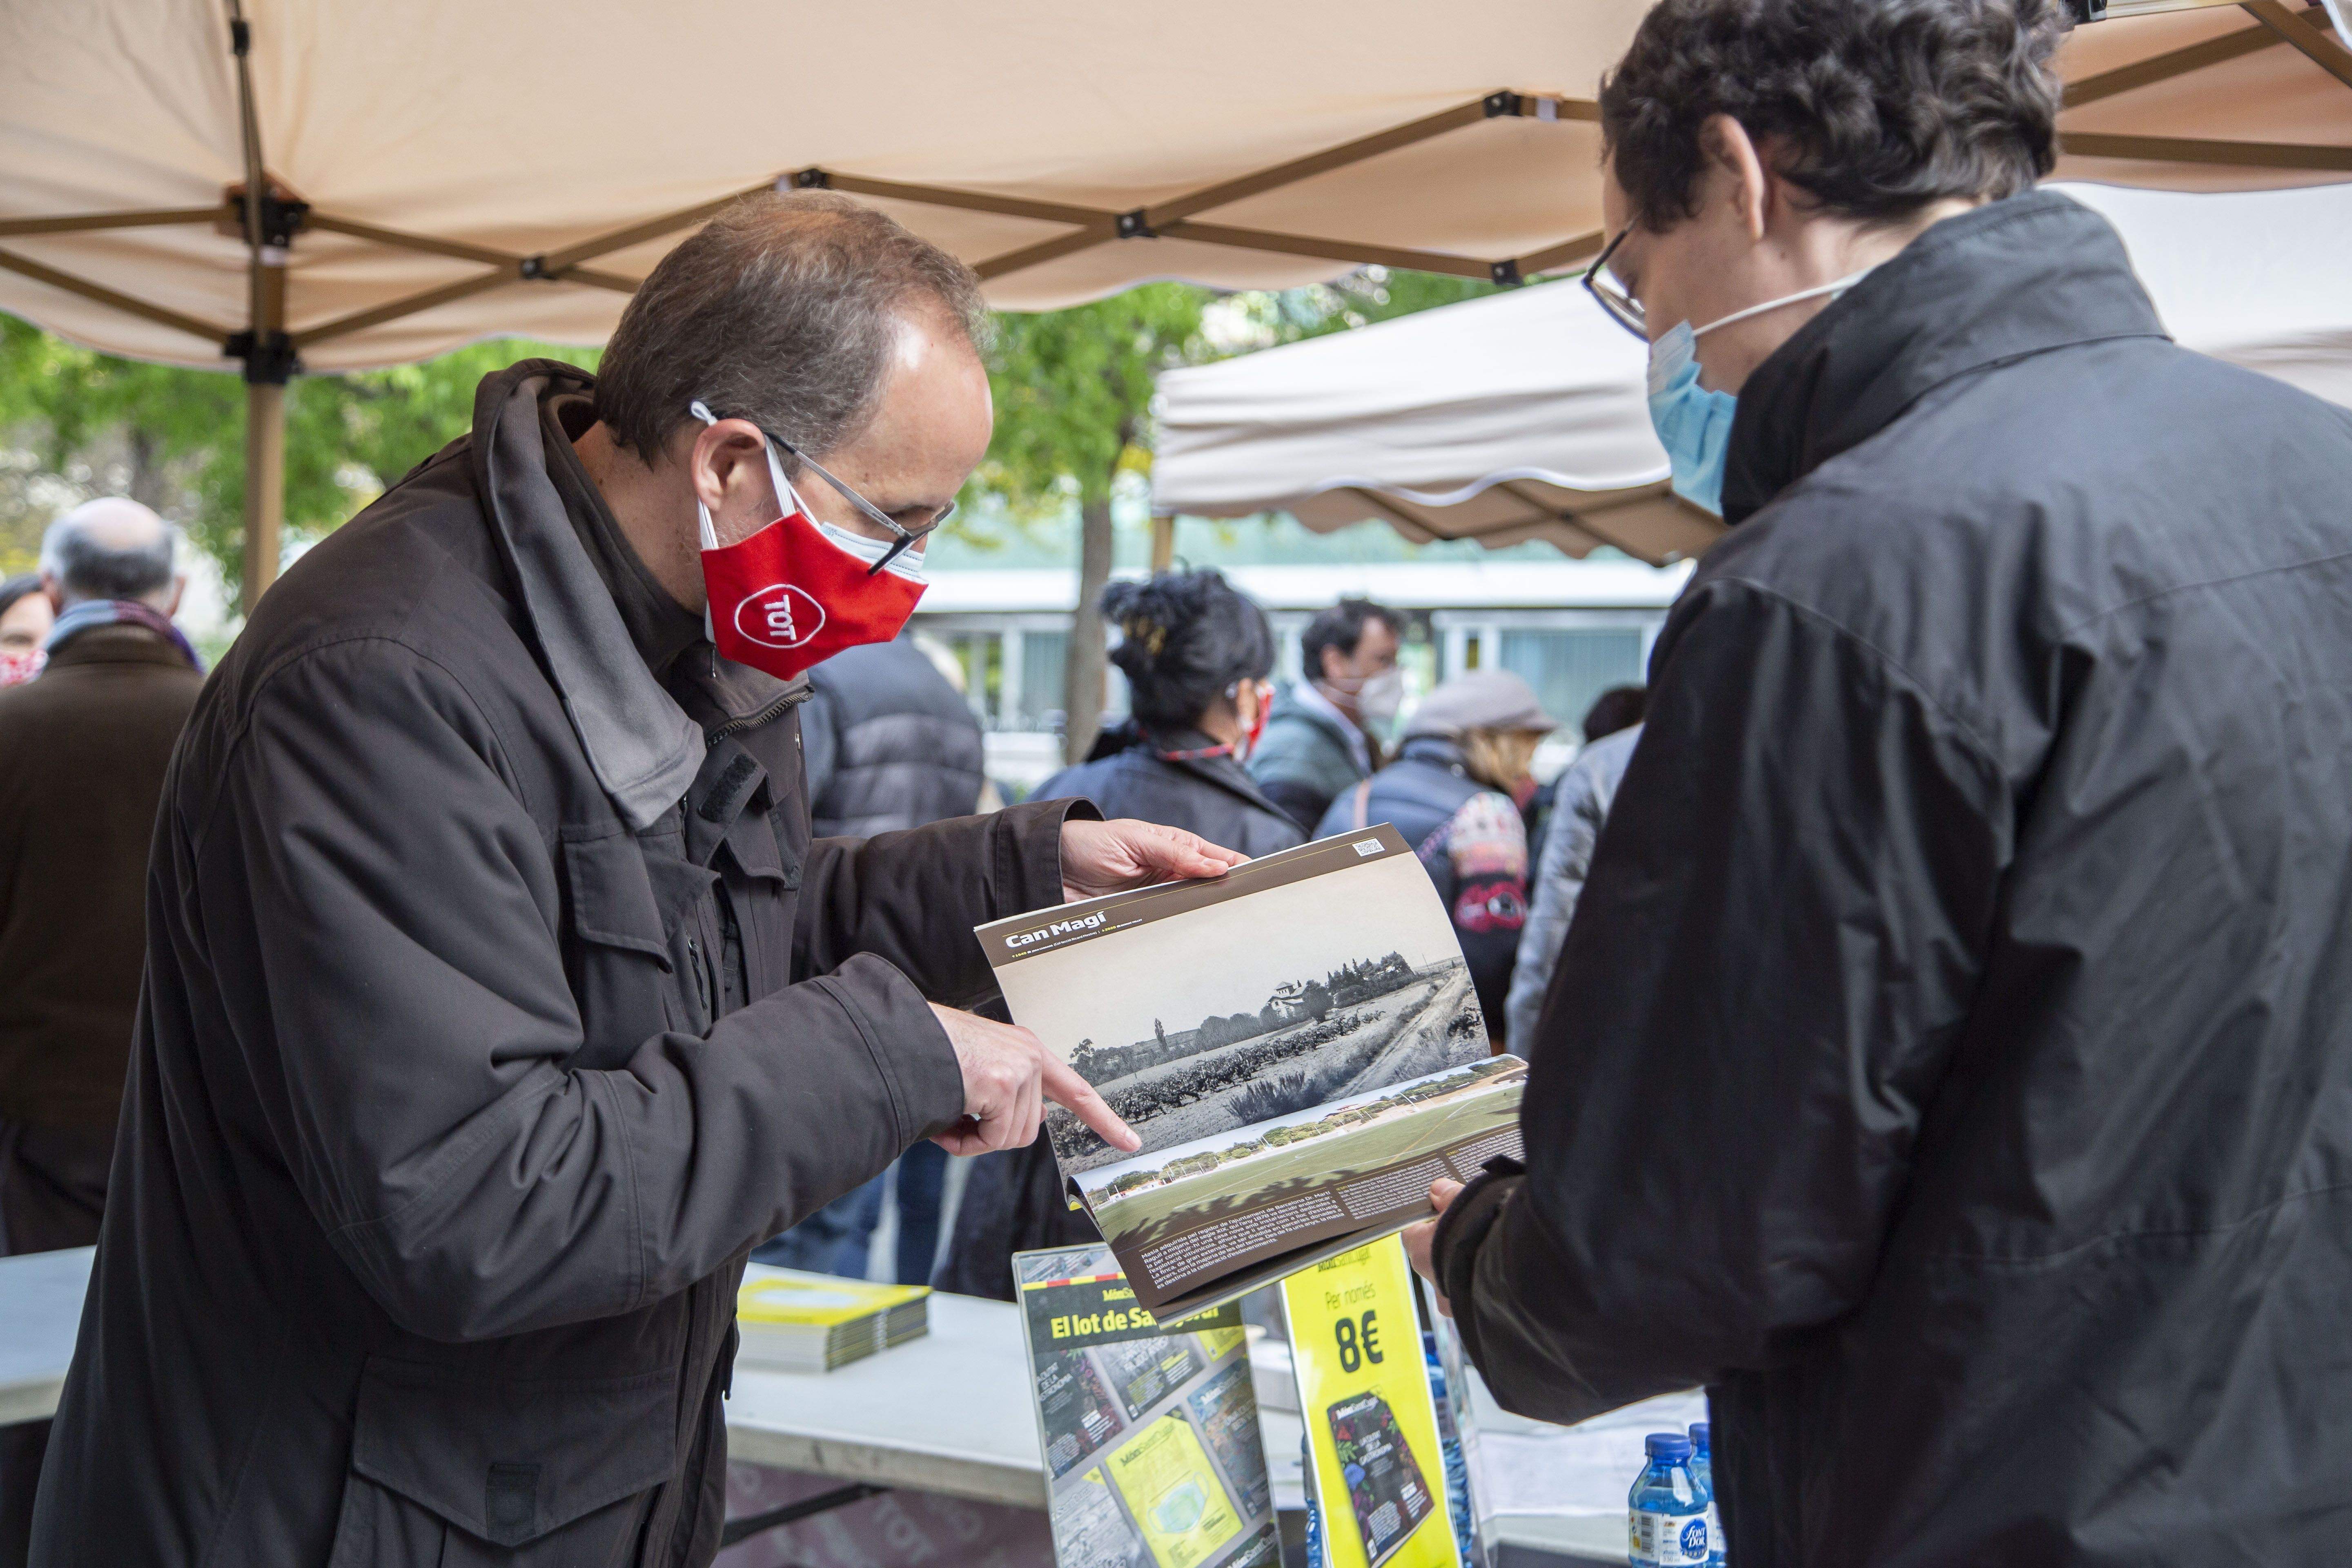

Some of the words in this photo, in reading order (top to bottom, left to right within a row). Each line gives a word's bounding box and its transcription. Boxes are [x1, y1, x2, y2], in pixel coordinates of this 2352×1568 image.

[764, 594, 797, 641] TOT
[1005, 930, 1050, 948] Can
[1049, 911, 1107, 936] Magí
[1325, 1292, 1341, 1310] Per
[1344, 1281, 1376, 1305] només
[1051, 1315, 1071, 1339] El
[1071, 1313, 1102, 1336] lot
[1102, 1310, 1128, 1332] de
[1128, 1307, 1157, 1328] Sa
[1335, 1309, 1383, 1373] 8€
